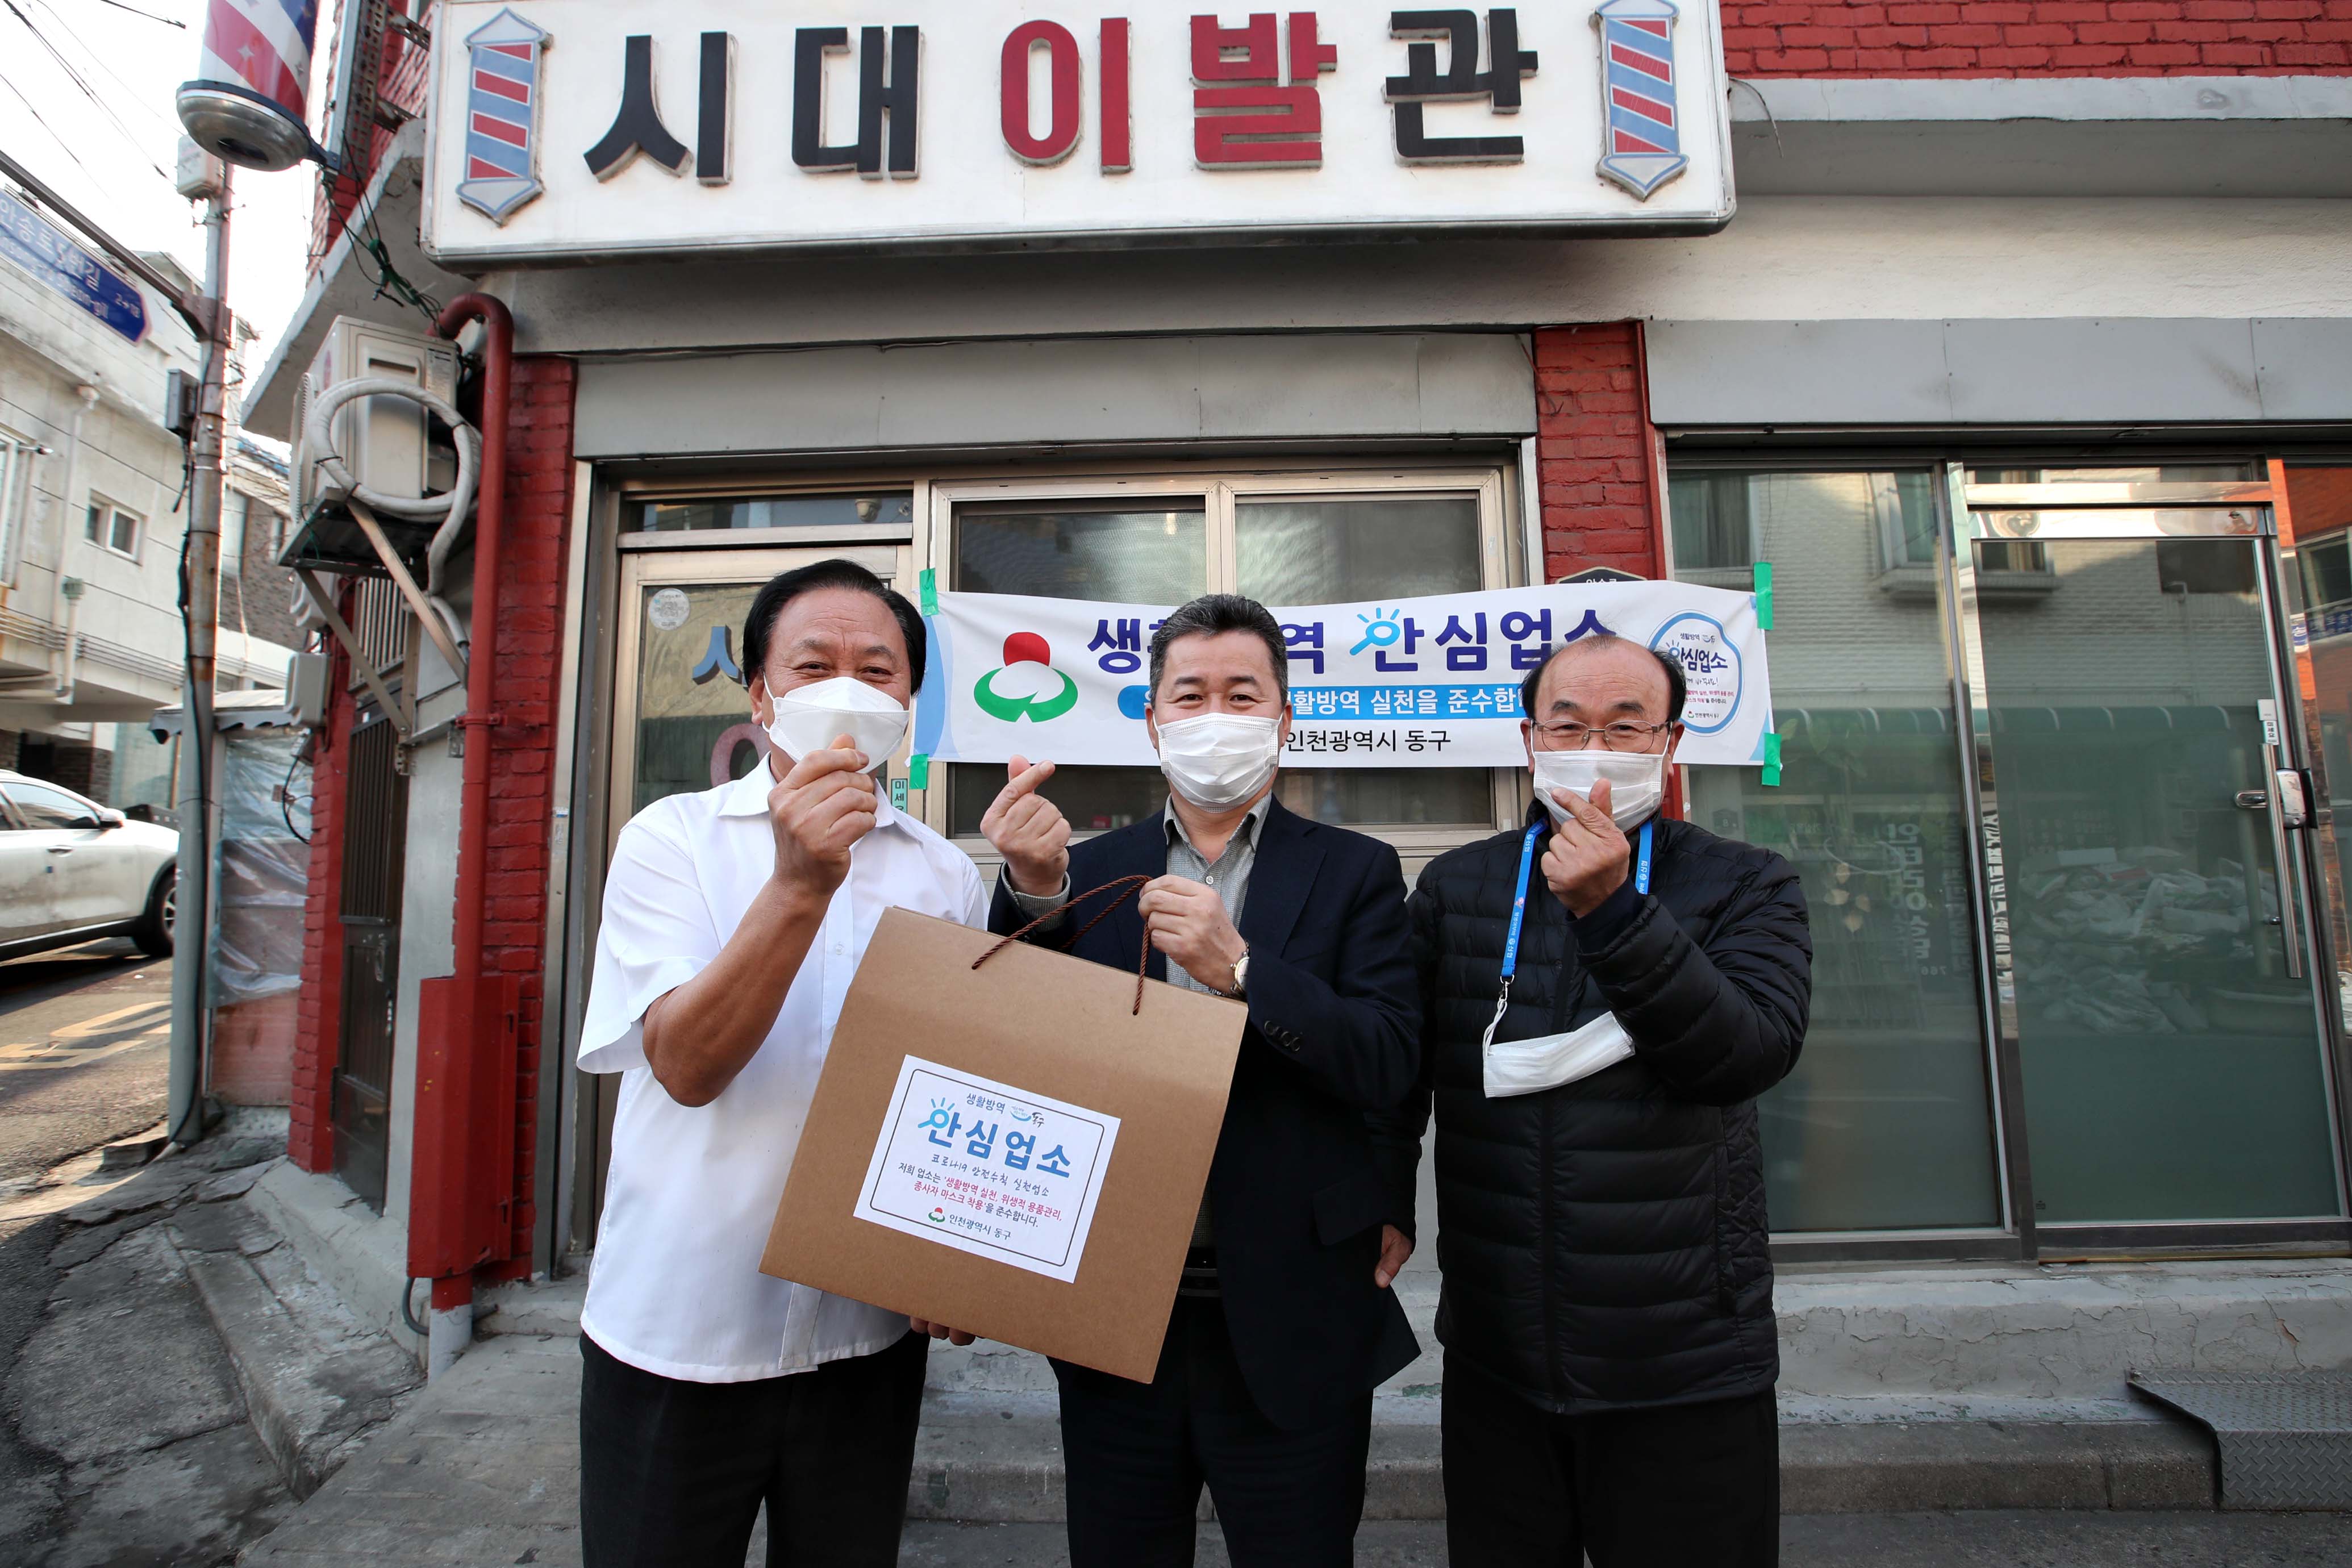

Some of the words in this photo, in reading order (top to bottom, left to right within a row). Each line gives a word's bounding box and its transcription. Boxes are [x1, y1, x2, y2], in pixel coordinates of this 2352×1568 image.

[1087, 618, 1324, 674] 생역
[1288, 690, 1360, 715] 활방역
[1370, 689, 1438, 715] 실천을
[1448, 687, 1524, 714] 준수합
[1286, 729, 1396, 752] 인천광역시
[1405, 729, 1451, 752] 동구
[966, 1092, 1006, 1114] 생활방역
[918, 1107, 1071, 1178] 안심업소
[898, 1162, 915, 1175] 저희
[918, 1168, 941, 1183] 업소는
[981, 1187, 998, 1202] 실천,
[1001, 1194, 1026, 1210] 위생적
[1028, 1202, 1062, 1221] 용품관리,
[931, 1154, 968, 1172] 코로나19
[972, 1166, 1008, 1186] 안전수칙
[1014, 1178, 1049, 1196] 실천업소
[914, 1181, 939, 1196] 종사자
[941, 1189, 965, 1203] 마스크
[996, 1206, 1039, 1227] 준수합니다.
[949, 1214, 991, 1235] 인천광역시
[994, 1228, 1011, 1240] 동구
